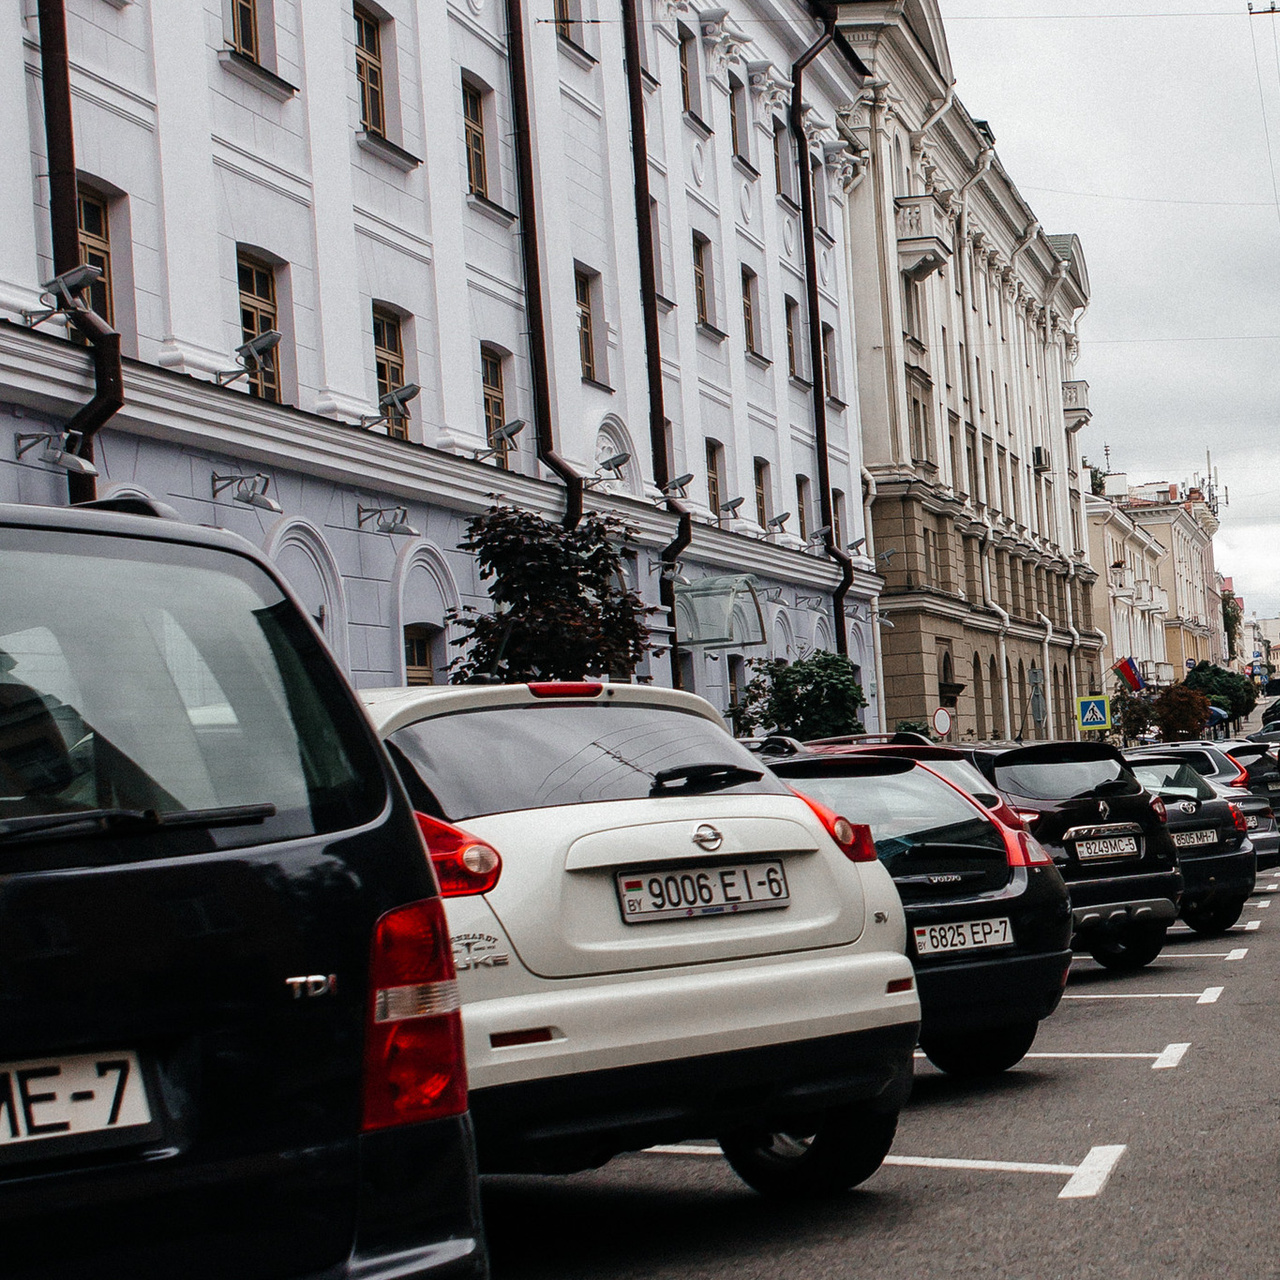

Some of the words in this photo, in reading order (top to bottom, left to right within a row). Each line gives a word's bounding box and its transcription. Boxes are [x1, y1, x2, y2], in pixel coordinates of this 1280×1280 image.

[649, 872, 714, 909] 9006
[719, 867, 782, 902] EI-6
[627, 898, 643, 912] BY
[929, 924, 967, 949] 6825
[970, 920, 1008, 945] EP-7
[918, 941, 927, 951] BY
[453, 952, 509, 971] UKE
